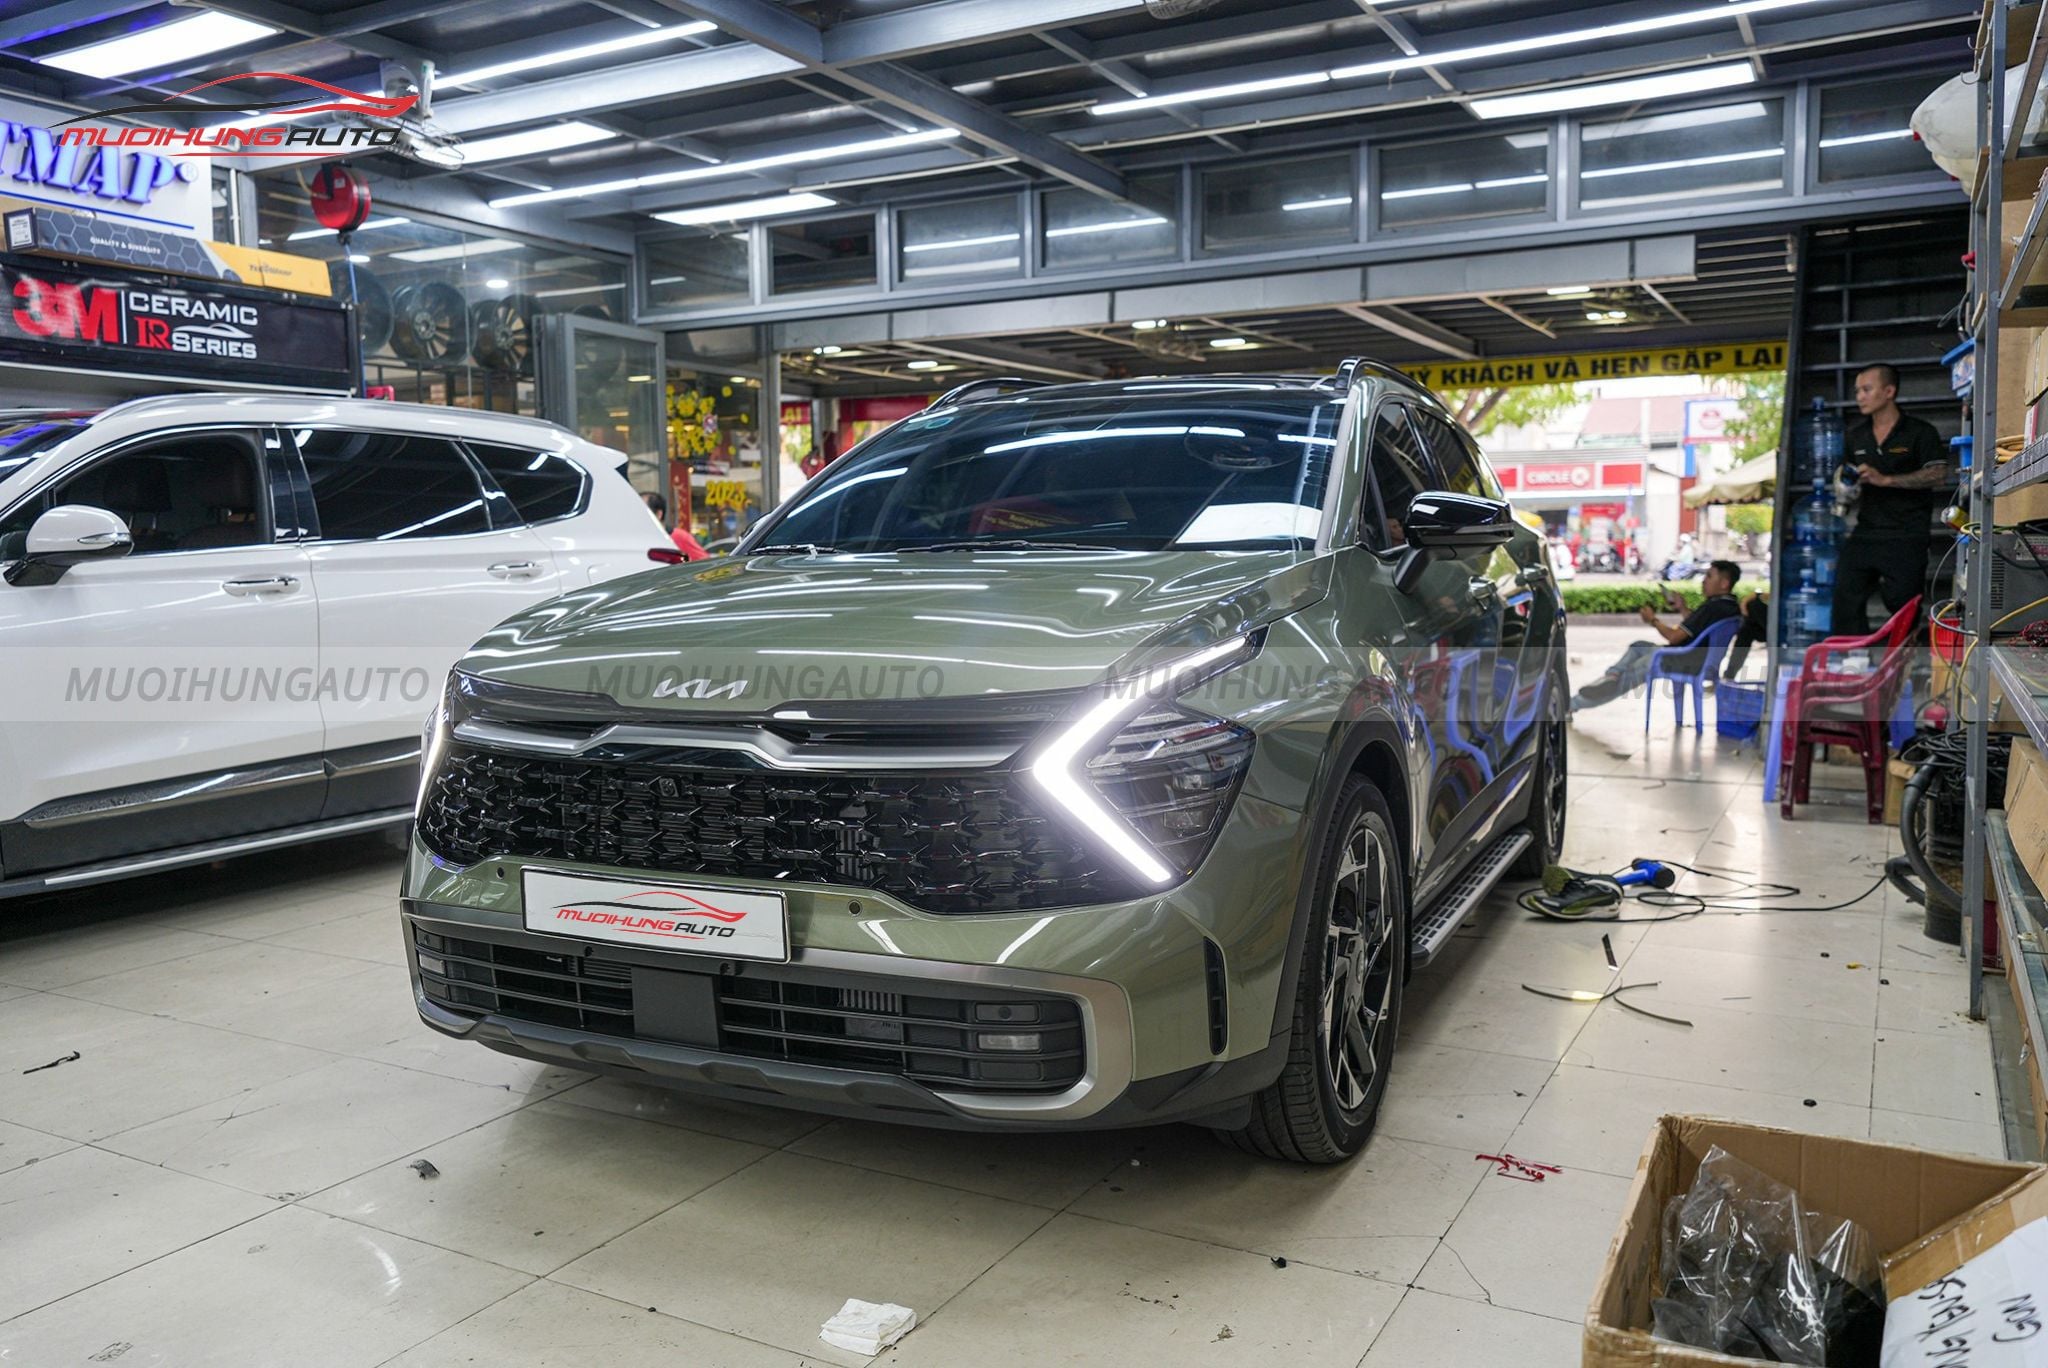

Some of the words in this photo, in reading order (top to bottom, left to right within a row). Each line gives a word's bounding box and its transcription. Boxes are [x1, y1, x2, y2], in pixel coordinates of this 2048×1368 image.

[12, 277, 121, 343] 3M
[129, 292, 258, 325] CERAMIC
[172, 331, 258, 359] SERIES
[1441, 362, 1534, 386] KHÁCH
[1544, 356, 1579, 378] VÀ
[1590, 354, 1650, 379] HẸN
[1661, 349, 1723, 375] GẶP
[1734, 346, 1784, 371] LẠI
[1526, 470, 1571, 486] CIRCLE
[705, 480, 746, 508] 2023
[652, 678, 750, 700] KIA
